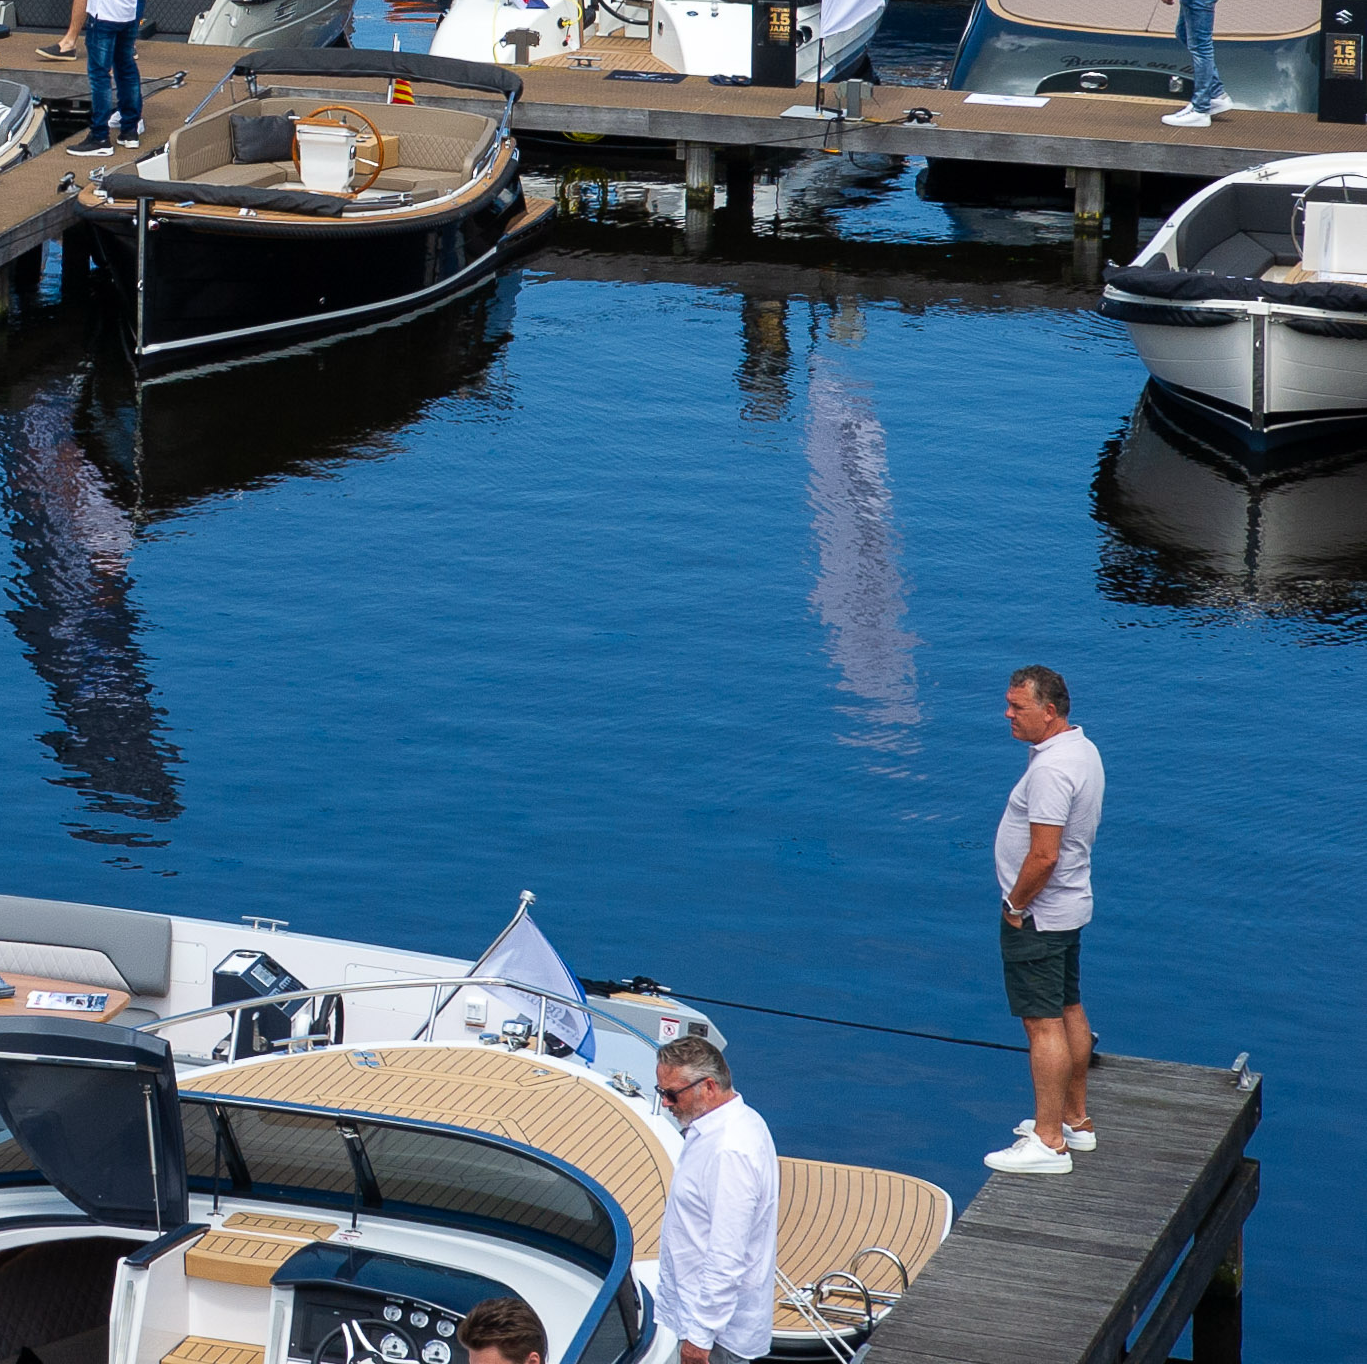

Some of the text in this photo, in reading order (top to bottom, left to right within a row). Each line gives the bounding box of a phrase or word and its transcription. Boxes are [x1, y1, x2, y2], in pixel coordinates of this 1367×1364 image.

[769, 13, 790, 25] 15
[1333, 46, 1356, 58] 15
[1333, 59, 1356, 67] JAAR
